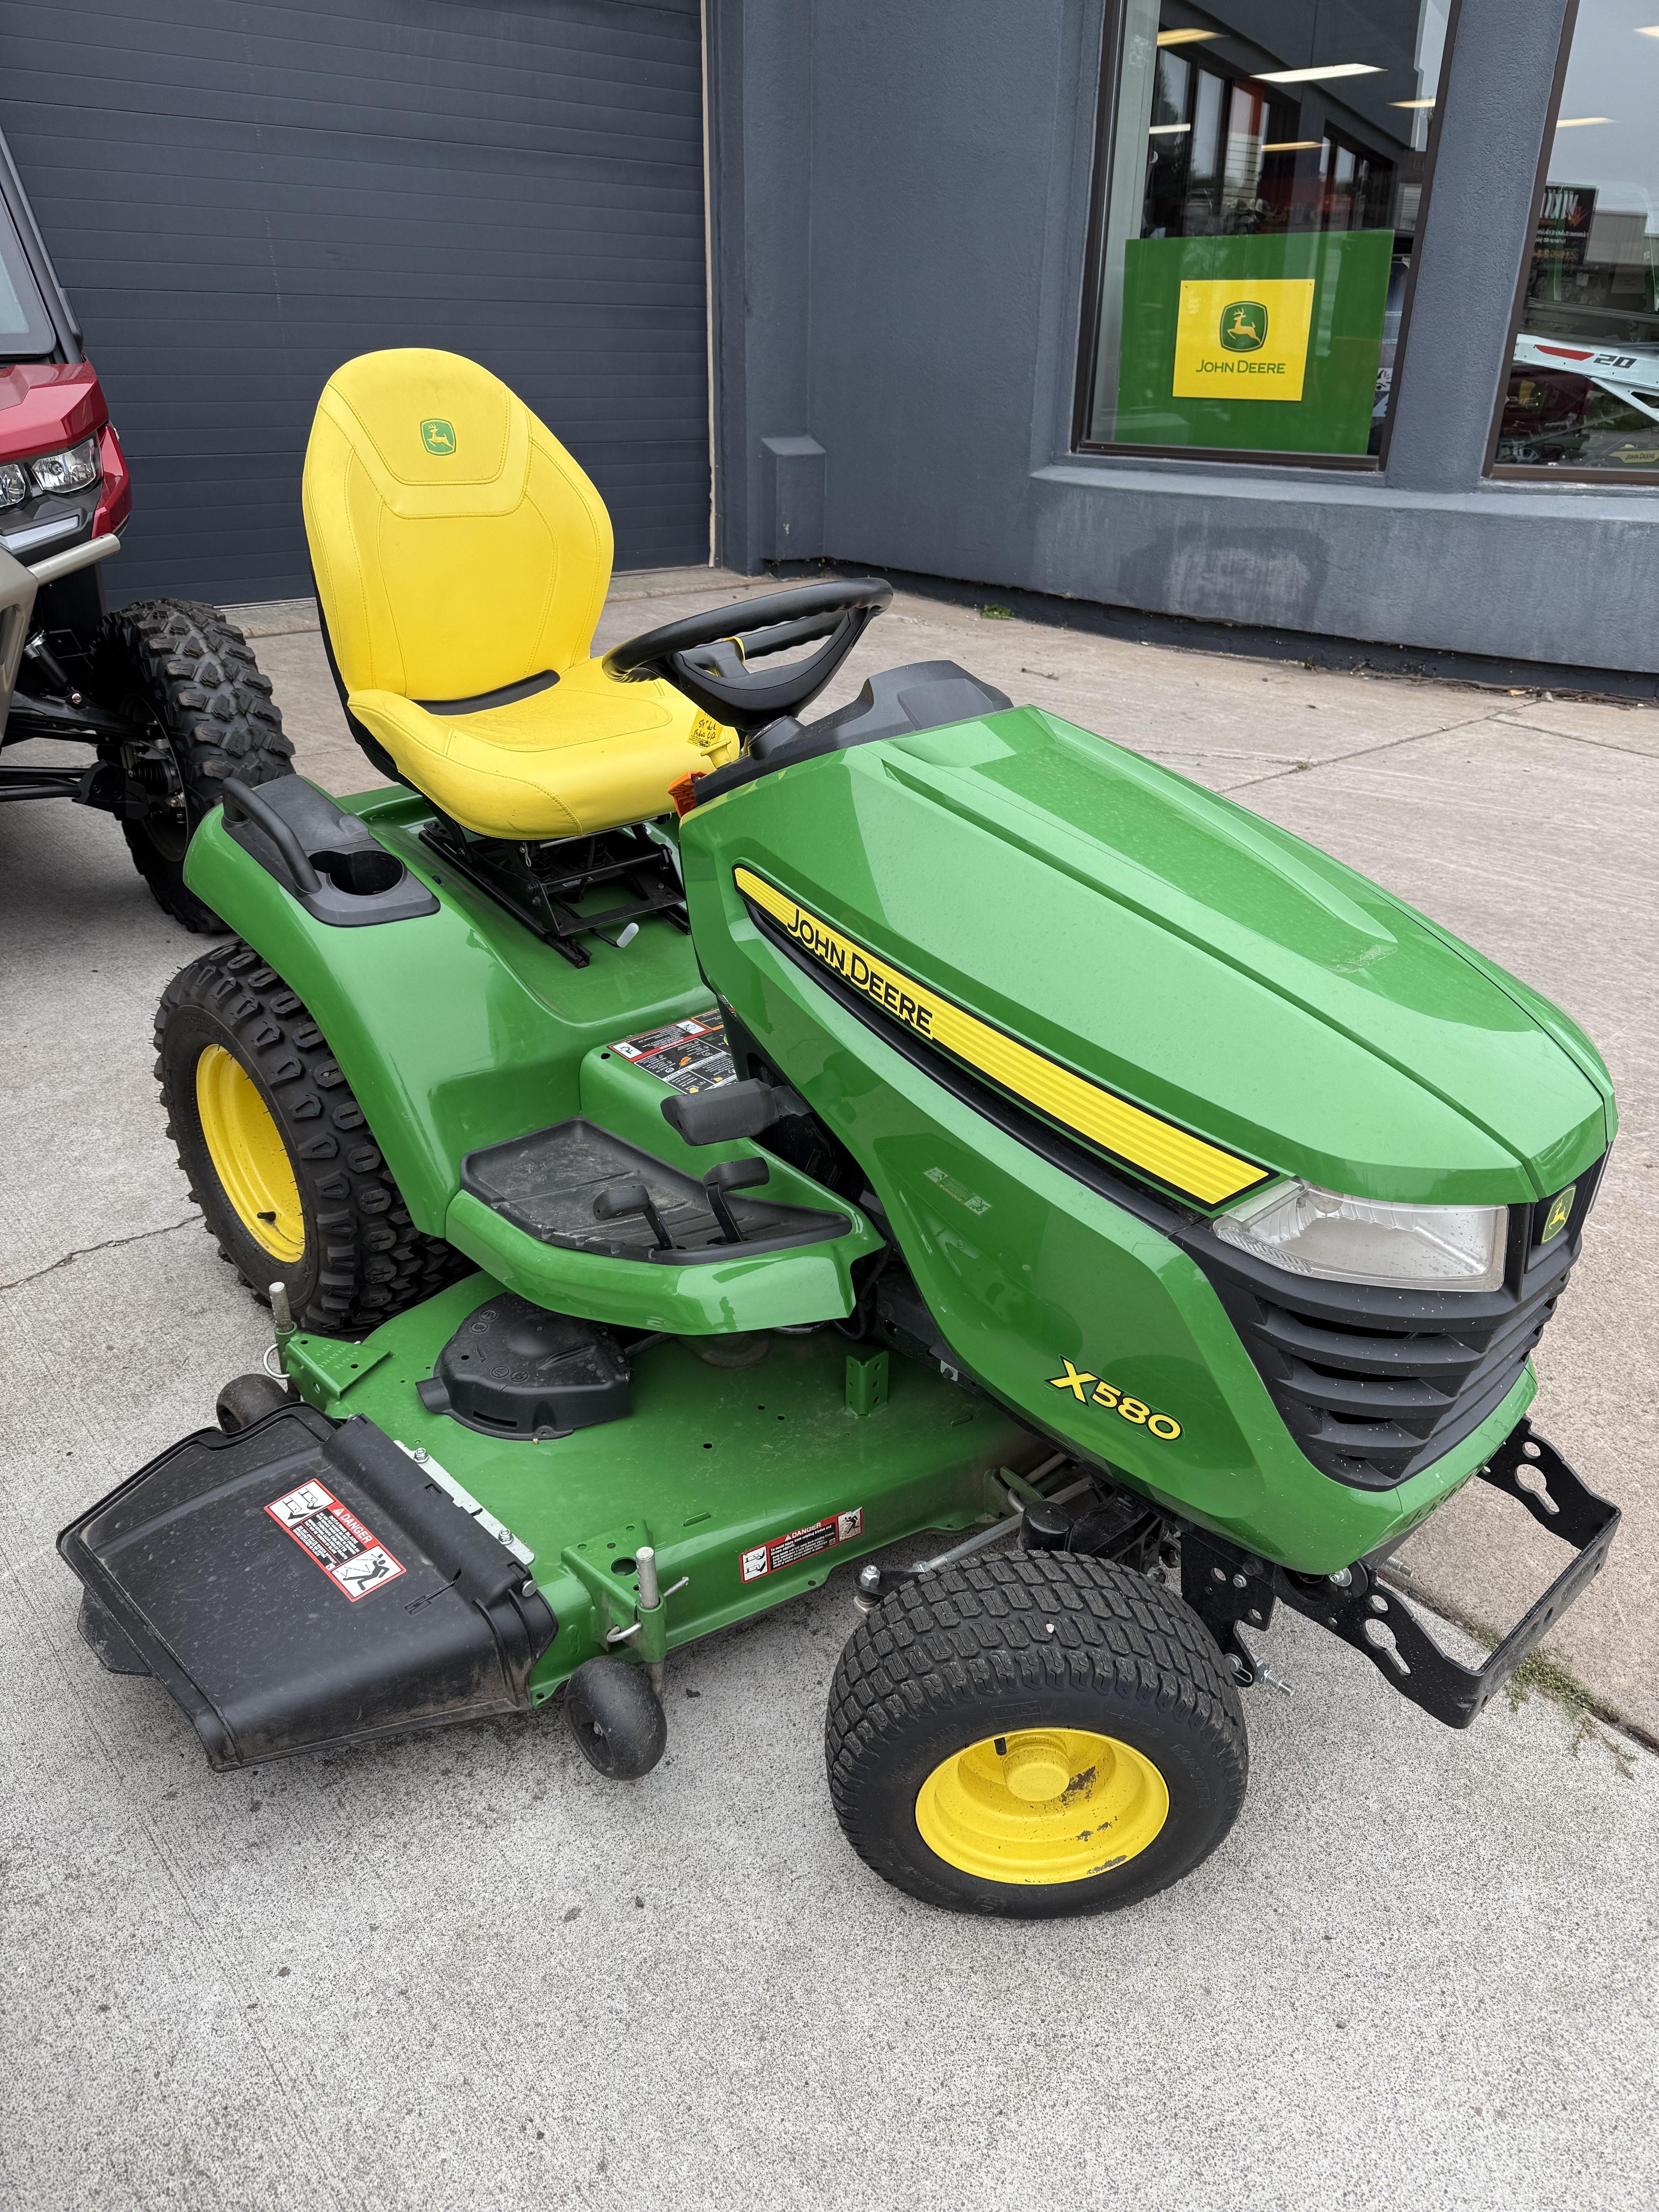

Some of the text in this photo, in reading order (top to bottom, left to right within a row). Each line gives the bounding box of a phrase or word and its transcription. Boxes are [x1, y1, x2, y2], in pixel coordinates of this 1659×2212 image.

[1196, 359, 1286, 374] JOHN DEERE
[1593, 354, 1637, 369] 20
[788, 908, 933, 1036] JOHN DEERE
[1045, 1355, 1183, 1441] X580
[315, 1521, 348, 1552] THROWN OBJECTS
[328, 1515, 359, 1544] ROTATING BLADE
[338, 1513, 374, 1544] DANGER
[792, 1522, 821, 1538] DANGER
